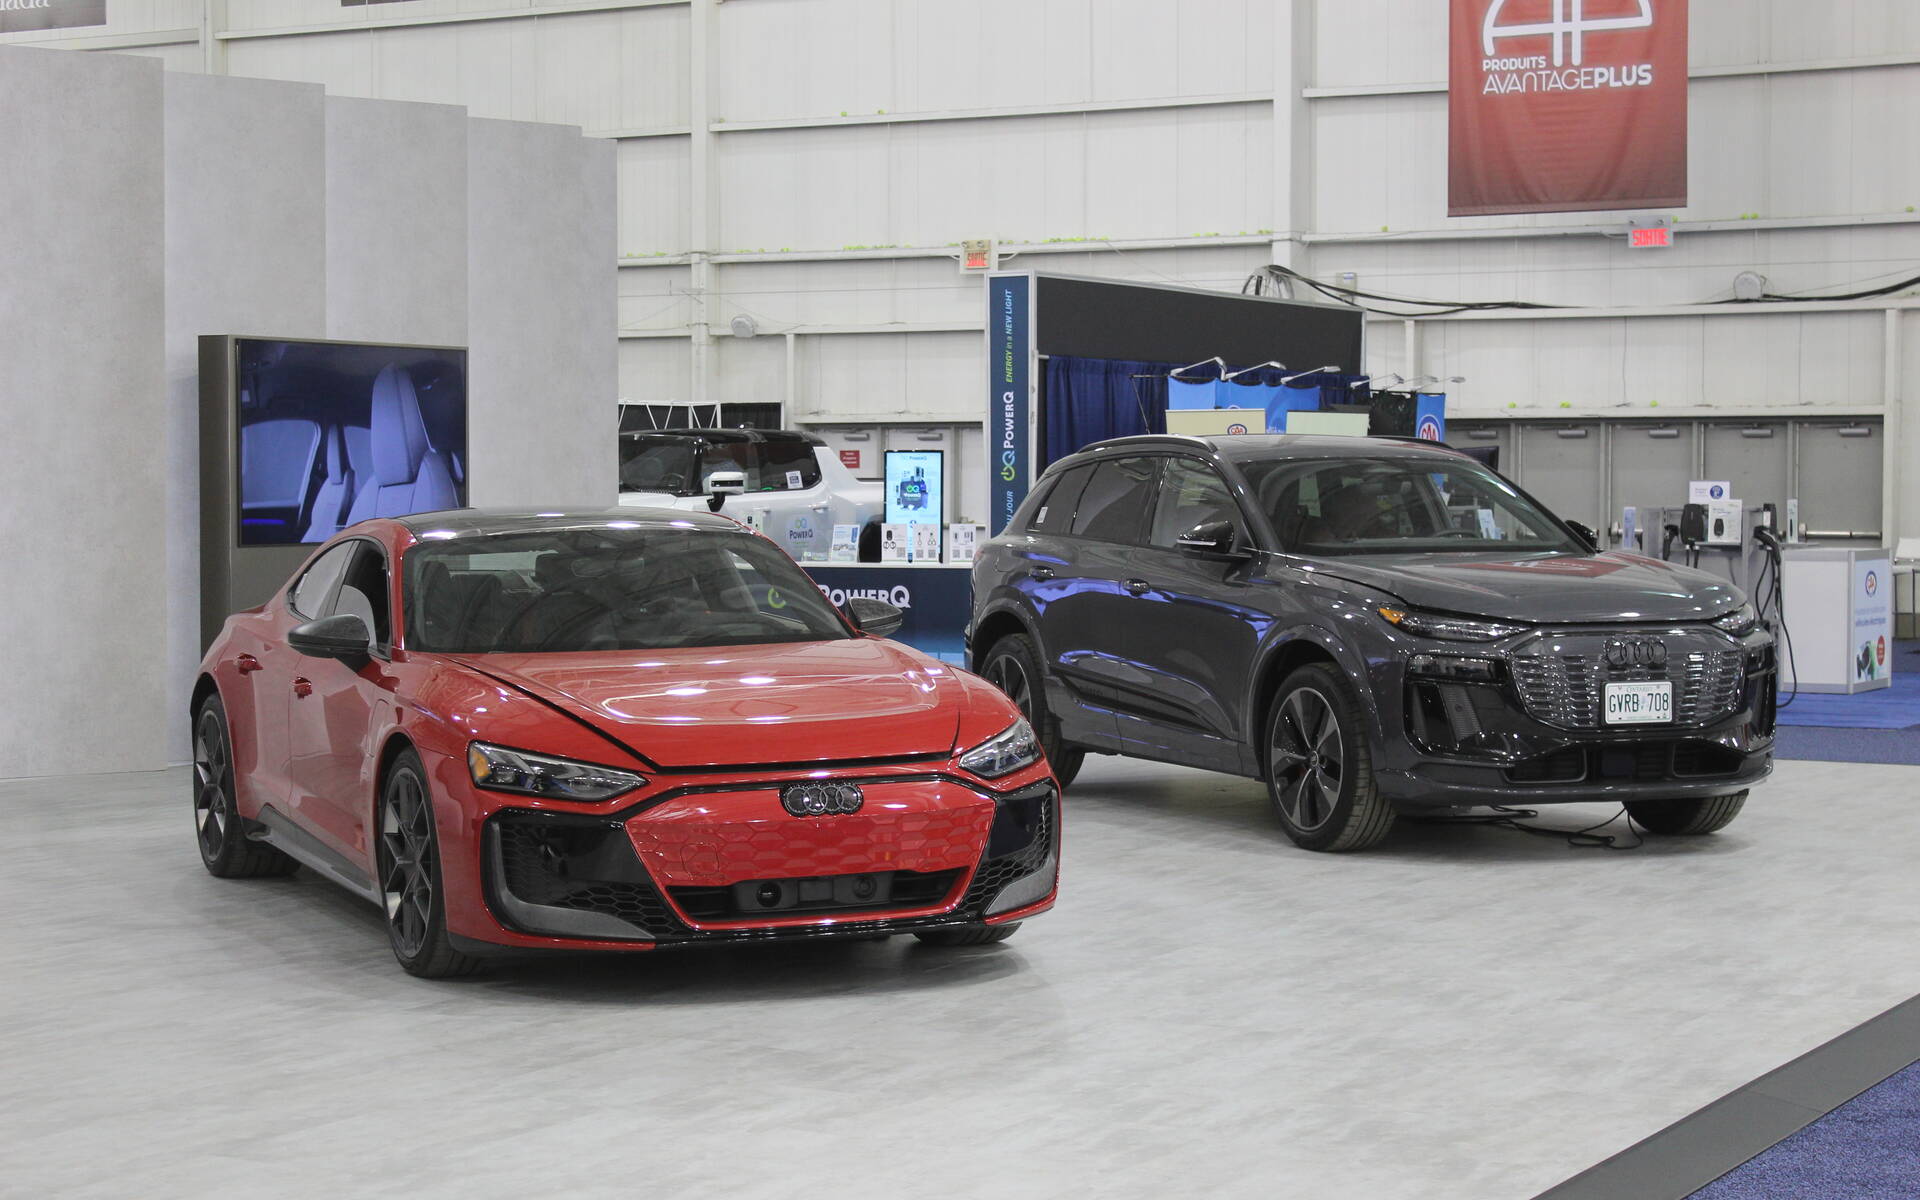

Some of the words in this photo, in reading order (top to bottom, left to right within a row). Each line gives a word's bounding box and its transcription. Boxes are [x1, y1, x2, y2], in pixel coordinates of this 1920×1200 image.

[1482, 56, 1547, 72] PRODUITS
[1631, 228, 1670, 247] SORTIE
[1005, 289, 1013, 314] LIGHT
[1005, 315, 1013, 335] NEW
[1006, 341, 1013, 350] in
[1005, 350, 1013, 383] ENERGY
[1003, 391, 1014, 449] POWERQ
[1006, 490, 1014, 514] JOUR
[1609, 693, 1640, 713] GVRB
[1647, 692, 1669, 712] 708
